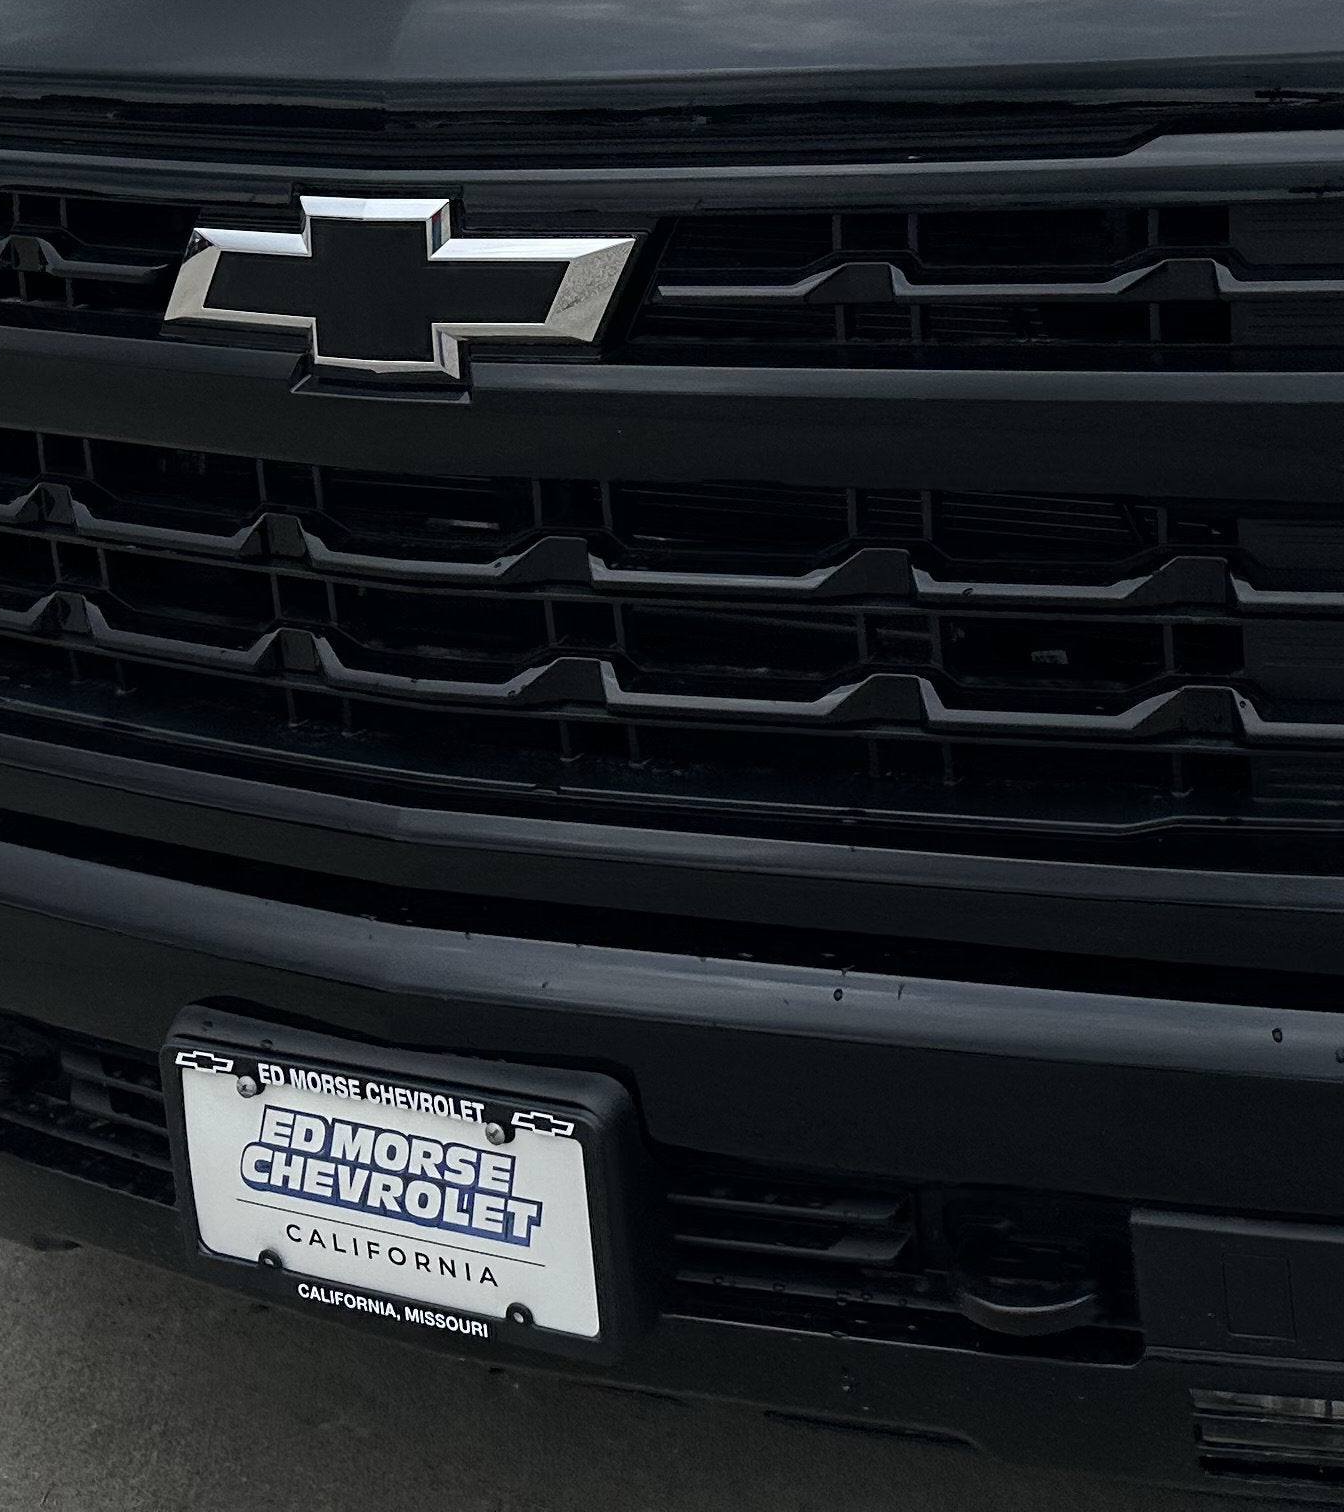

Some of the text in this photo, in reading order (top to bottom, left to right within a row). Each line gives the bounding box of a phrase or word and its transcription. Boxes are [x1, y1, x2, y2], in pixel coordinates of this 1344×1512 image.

[257, 1062, 485, 1124] ED MORSE CHEVROLET
[240, 1105, 542, 1244] ED MORSE CHEVROLET
[285, 1223, 499, 1288] CALIFORNIA
[297, 1283, 489, 1339] CALIFORNIA, MISSOURI
